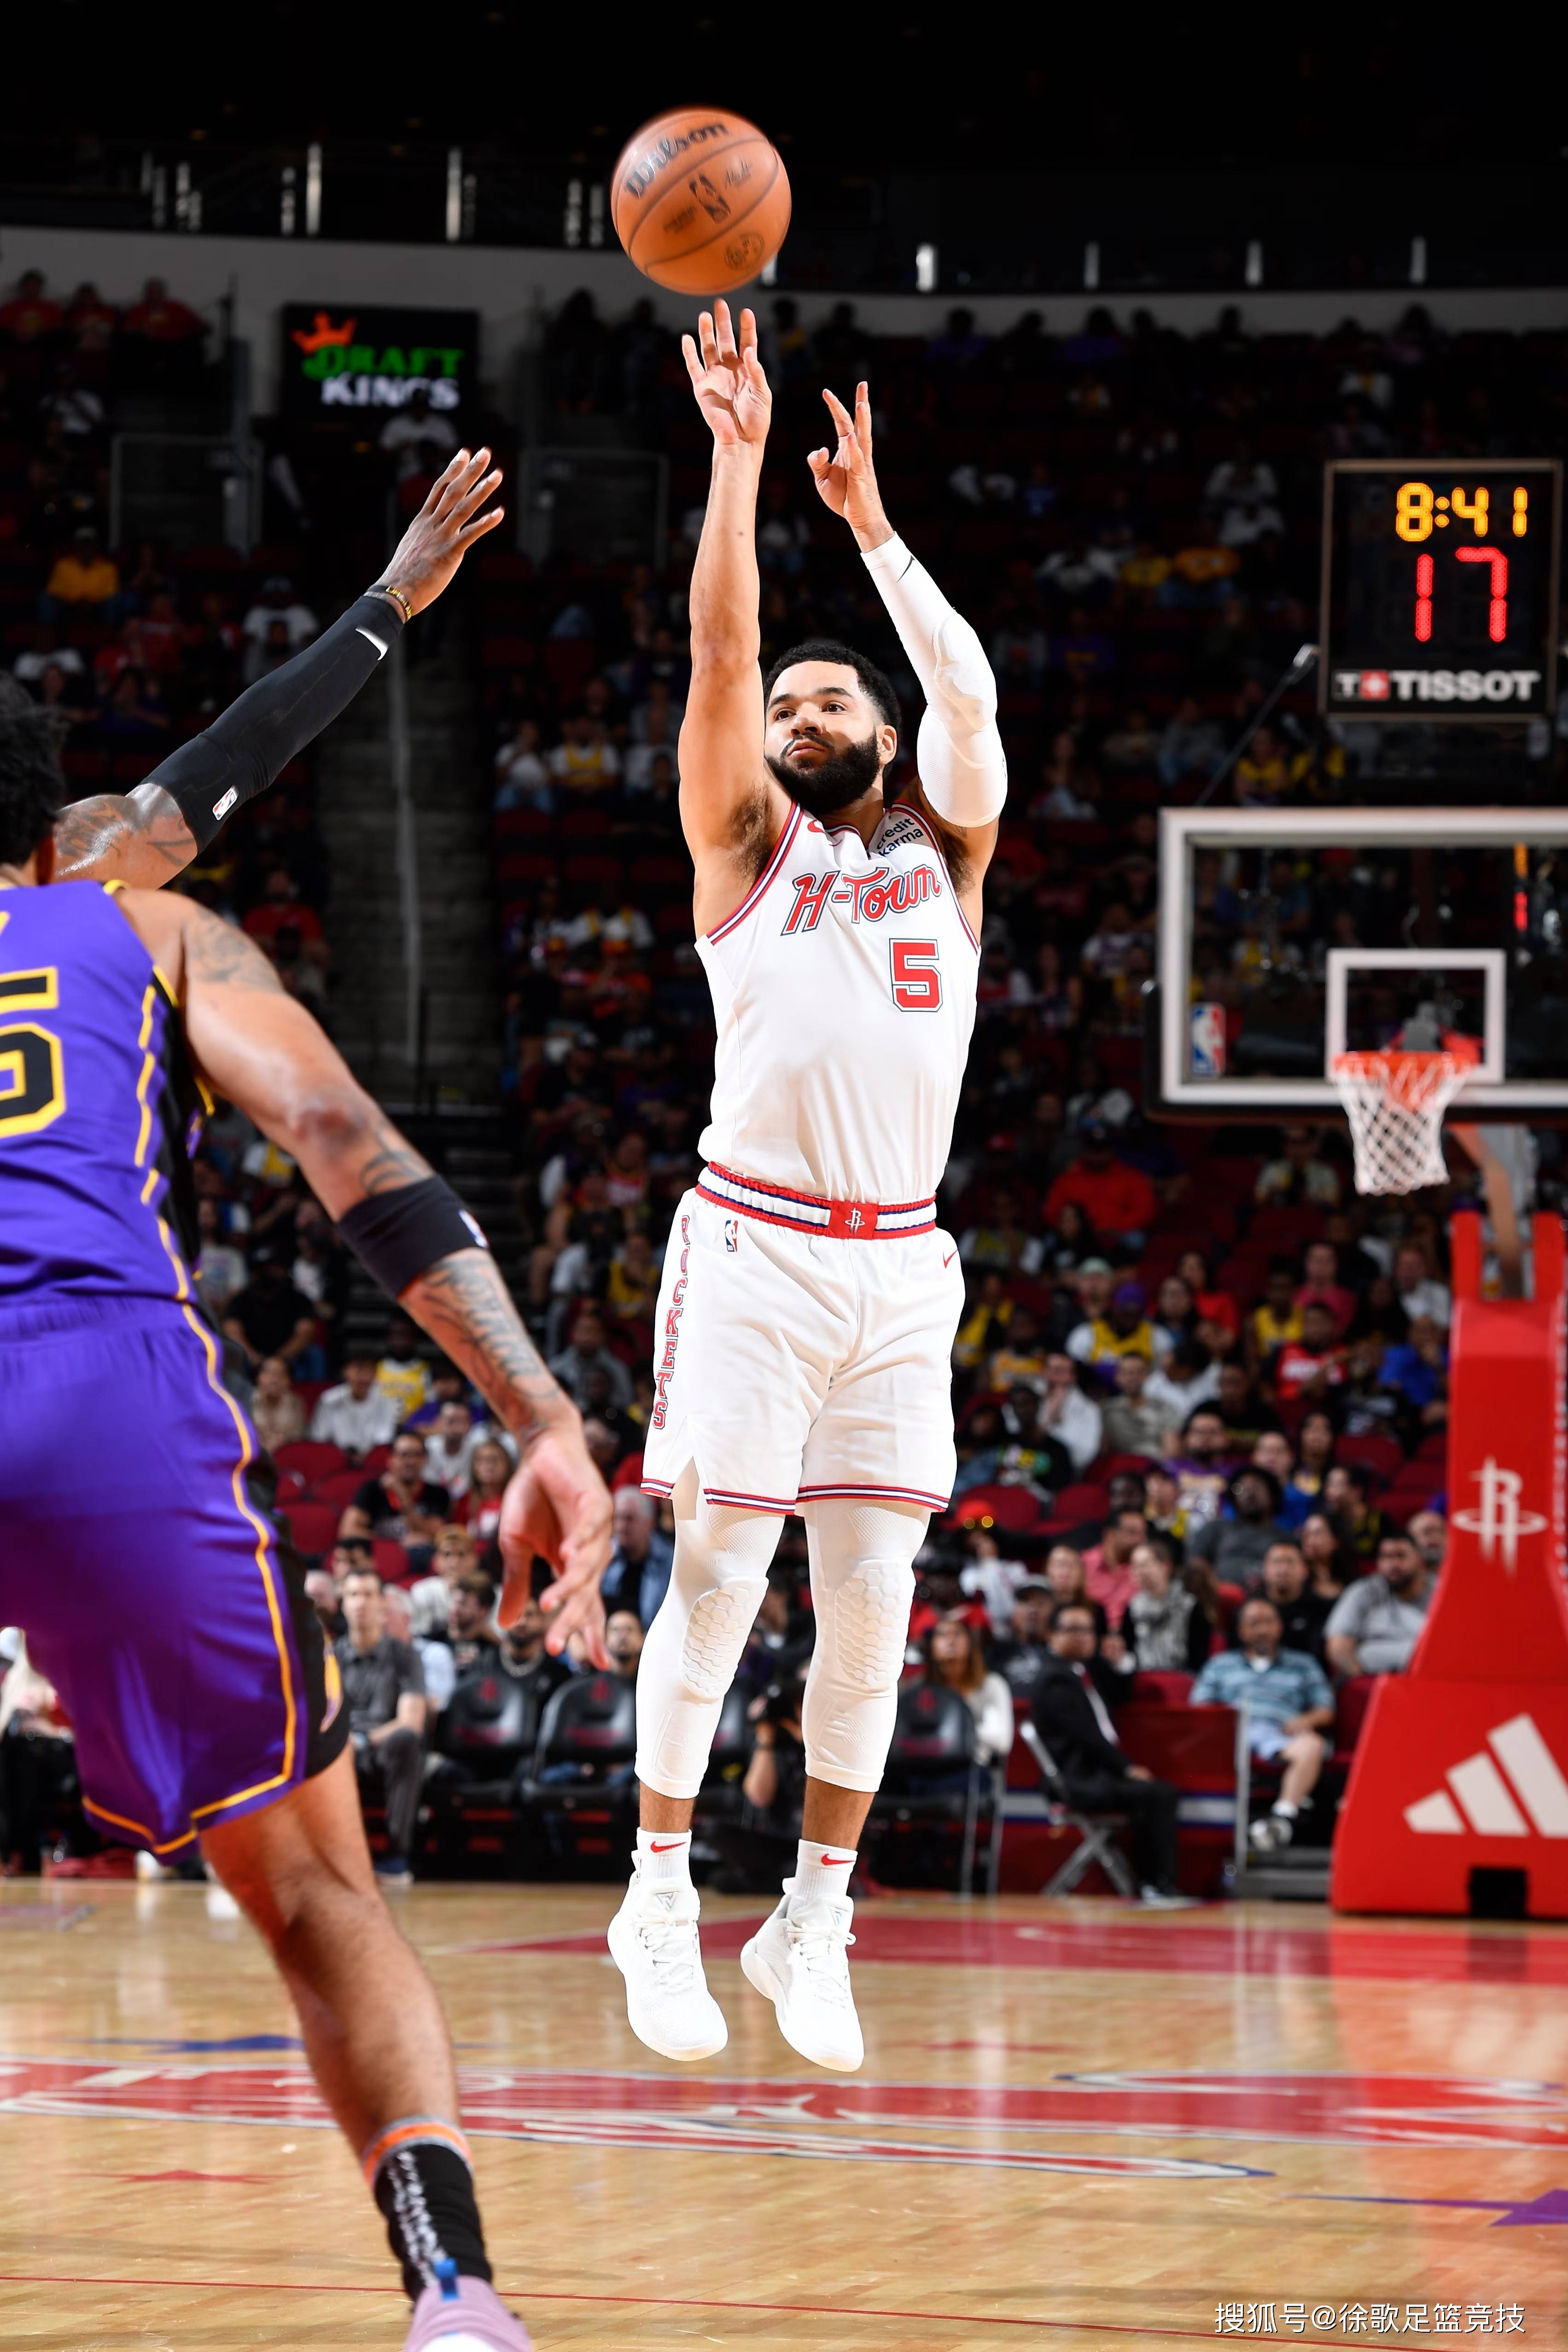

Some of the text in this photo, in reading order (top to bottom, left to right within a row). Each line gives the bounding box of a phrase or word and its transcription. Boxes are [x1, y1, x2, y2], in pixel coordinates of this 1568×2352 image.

[302, 343, 464, 381] DRAFT
[1395, 483, 1528, 542] 8:41
[1415, 547, 1508, 642] 17
[1392, 670, 1541, 702] TISSOT
[877, 818, 915, 850] credit
[878, 828, 924, 857] karma
[780, 864, 942, 937] H-Town
[889, 938, 943, 1013] 5
[653, 1214, 690, 1430] ROCKETS
